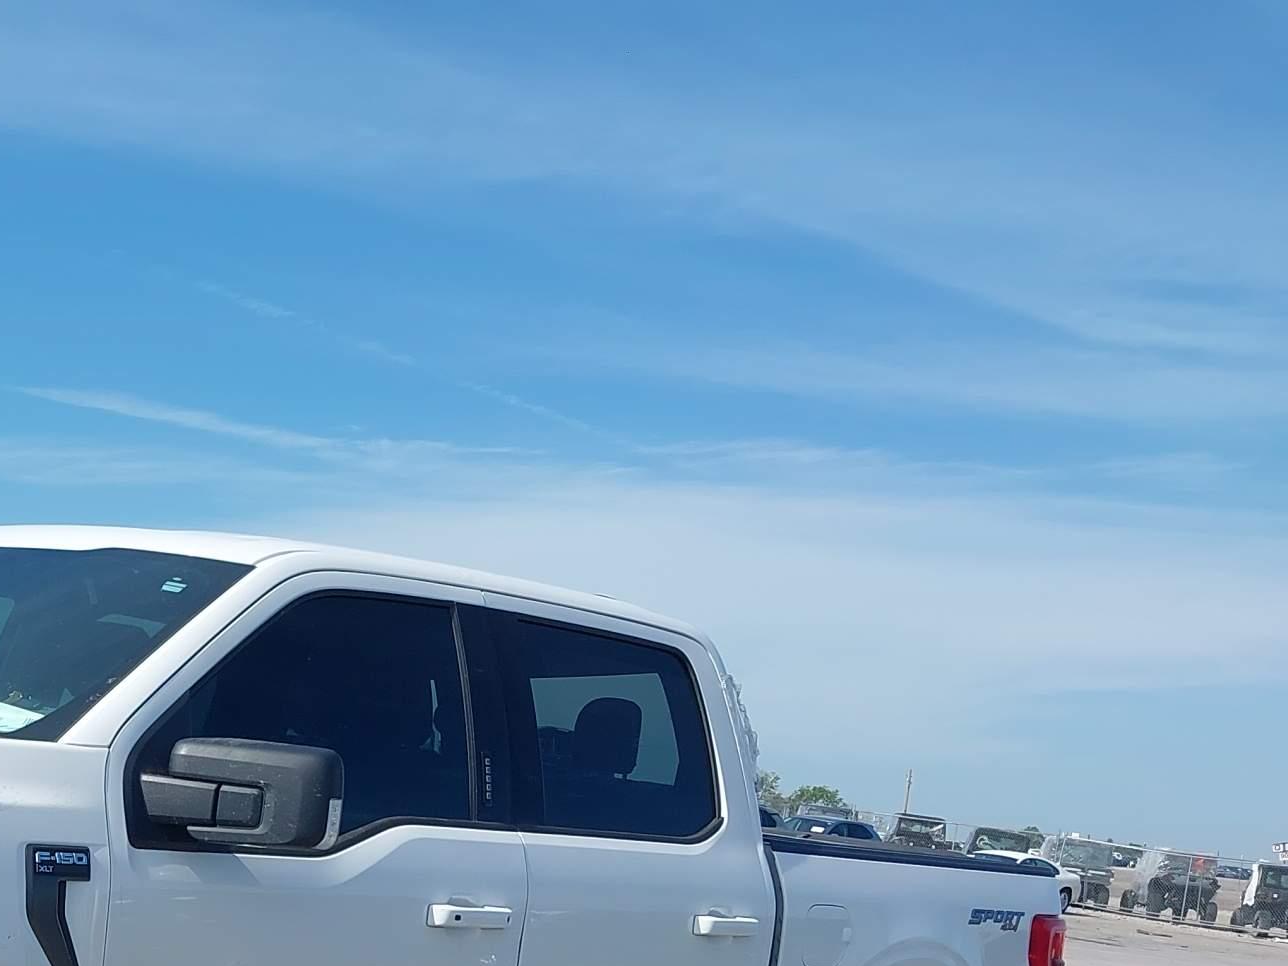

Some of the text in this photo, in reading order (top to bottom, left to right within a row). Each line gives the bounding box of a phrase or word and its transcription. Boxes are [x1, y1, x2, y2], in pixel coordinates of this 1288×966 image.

[35, 851, 88, 864] F-150
[39, 865, 54, 873] XLT
[968, 908, 1025, 927] SPORT
